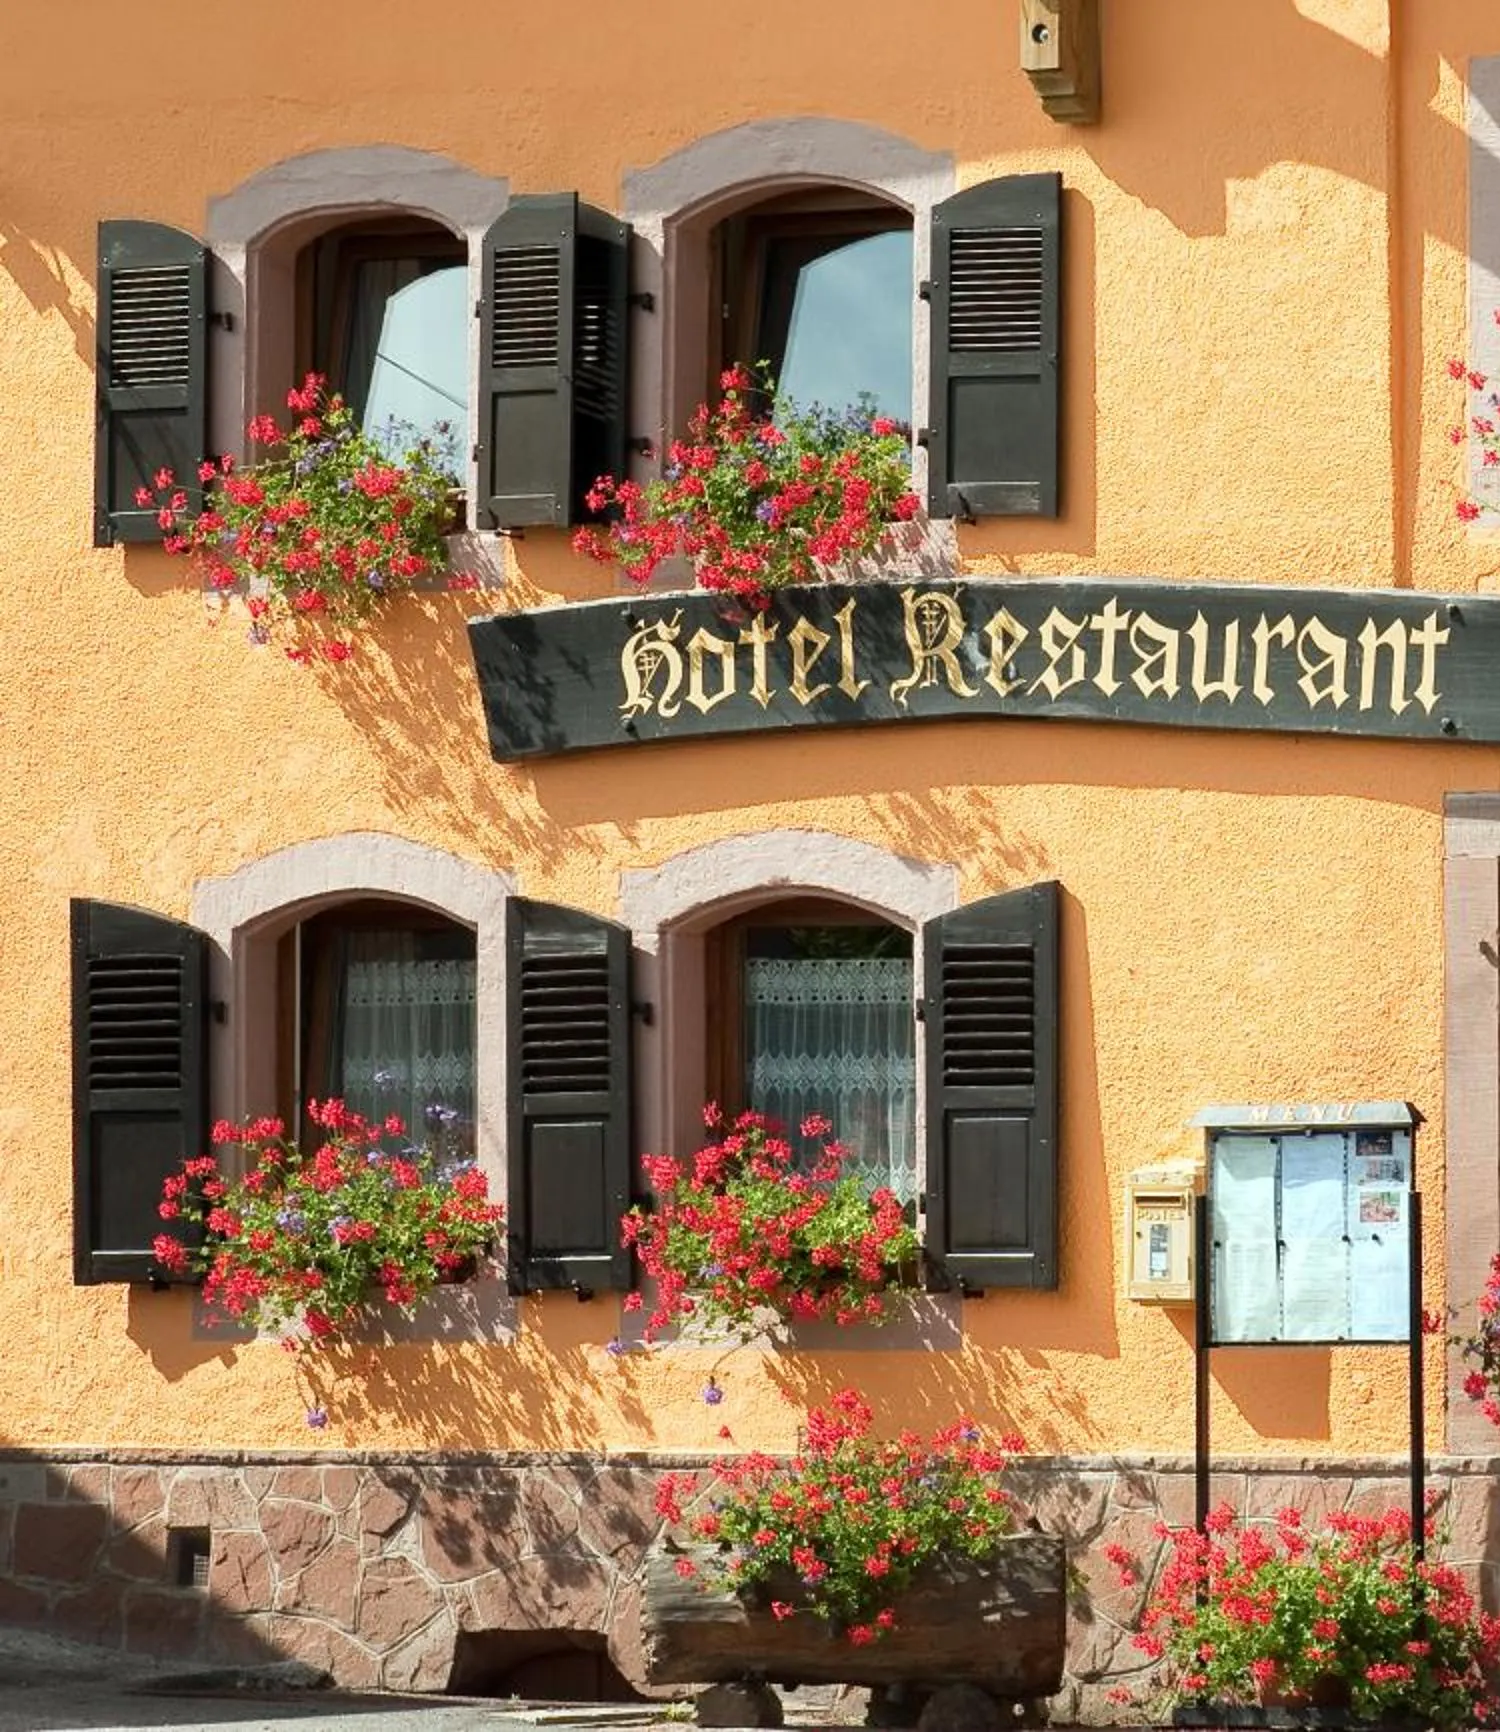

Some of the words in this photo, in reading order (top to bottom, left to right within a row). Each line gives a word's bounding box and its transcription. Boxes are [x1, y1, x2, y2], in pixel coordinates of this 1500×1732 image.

[619, 597, 872, 720] Hotel
[889, 583, 1451, 715] Restaurant
[1250, 1104, 1355, 1121] MENU
